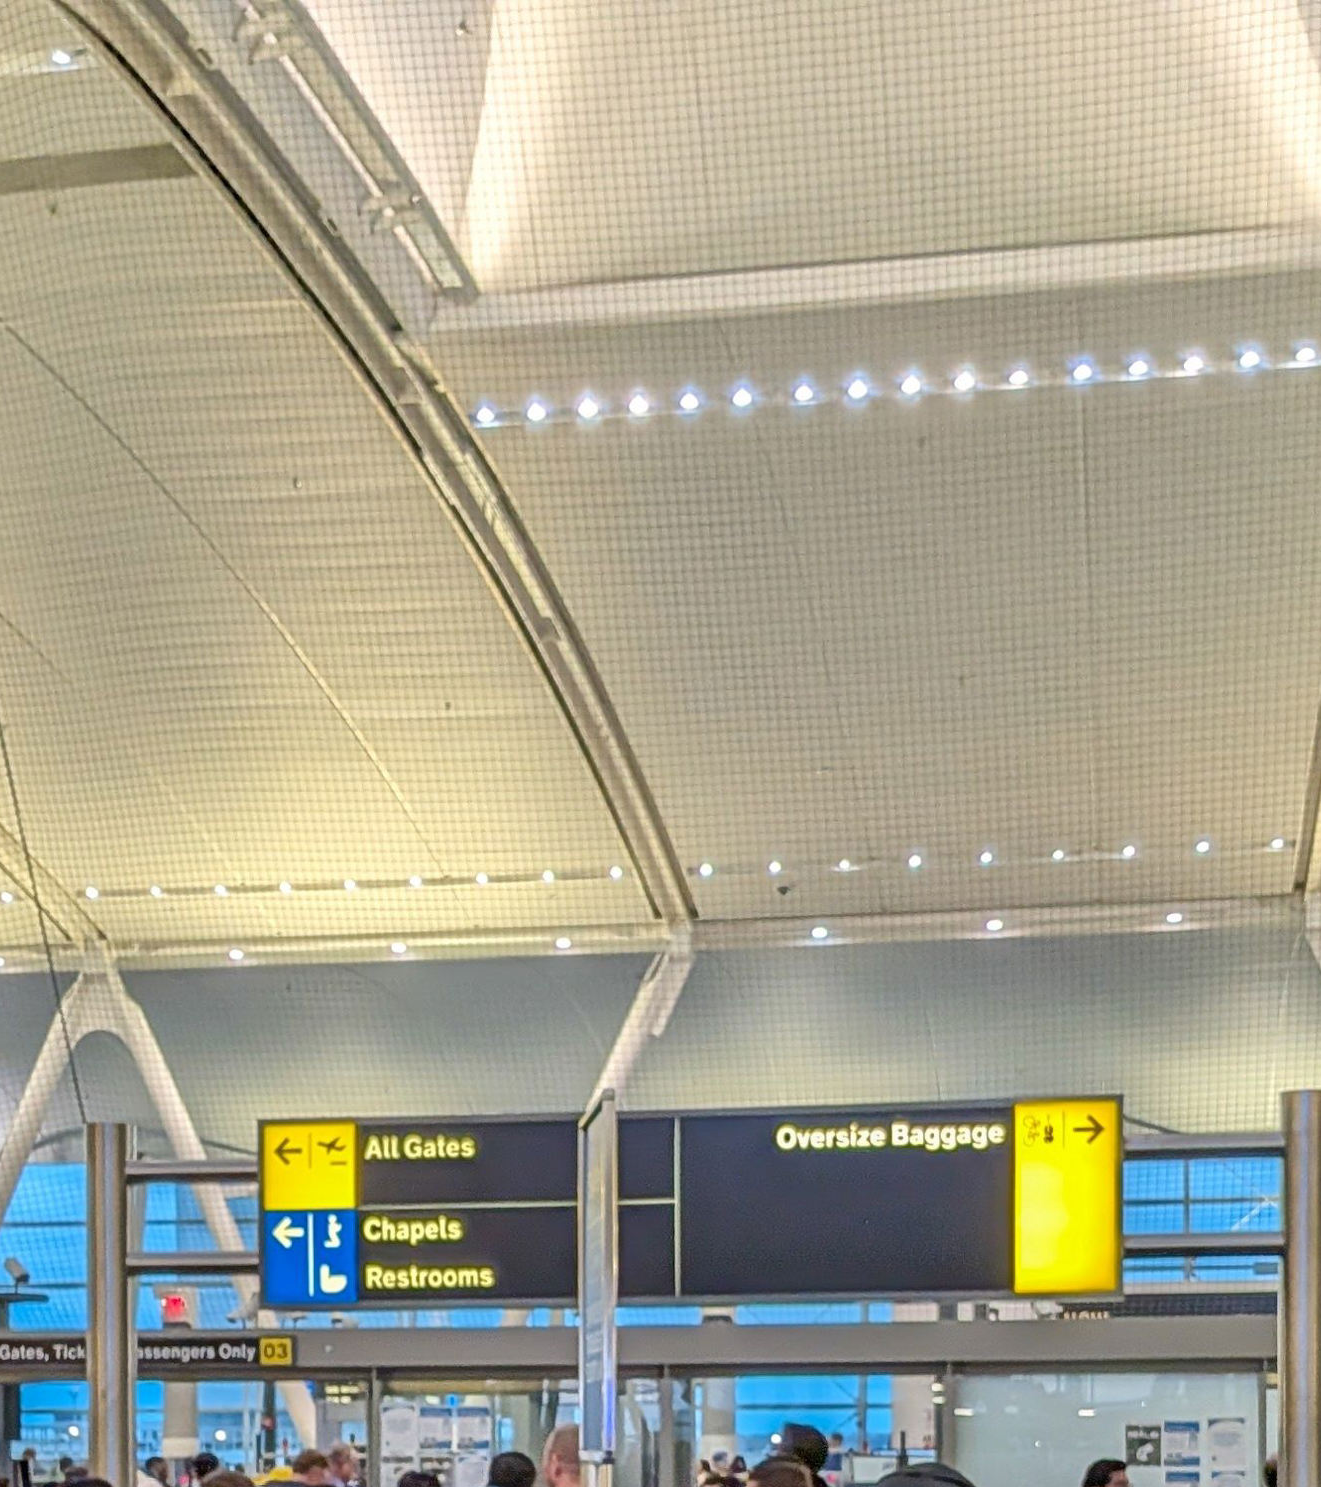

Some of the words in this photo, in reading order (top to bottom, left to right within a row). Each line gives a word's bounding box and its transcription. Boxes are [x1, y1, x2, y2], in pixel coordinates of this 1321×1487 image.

[364, 1134, 400, 1160] All
[403, 1133, 476, 1160] Gates
[776, 1121, 886, 1150] Oversize
[891, 1120, 1006, 1150] Baggage
[363, 1214, 463, 1246] Chapels
[365, 1264, 496, 1289] Restrooms
[52, 1343, 86, 1360] Tick
[137, 1346, 216, 1363] assengers
[218, 1343, 256, 1362] Only
[264, 1344, 288, 1359] 03
